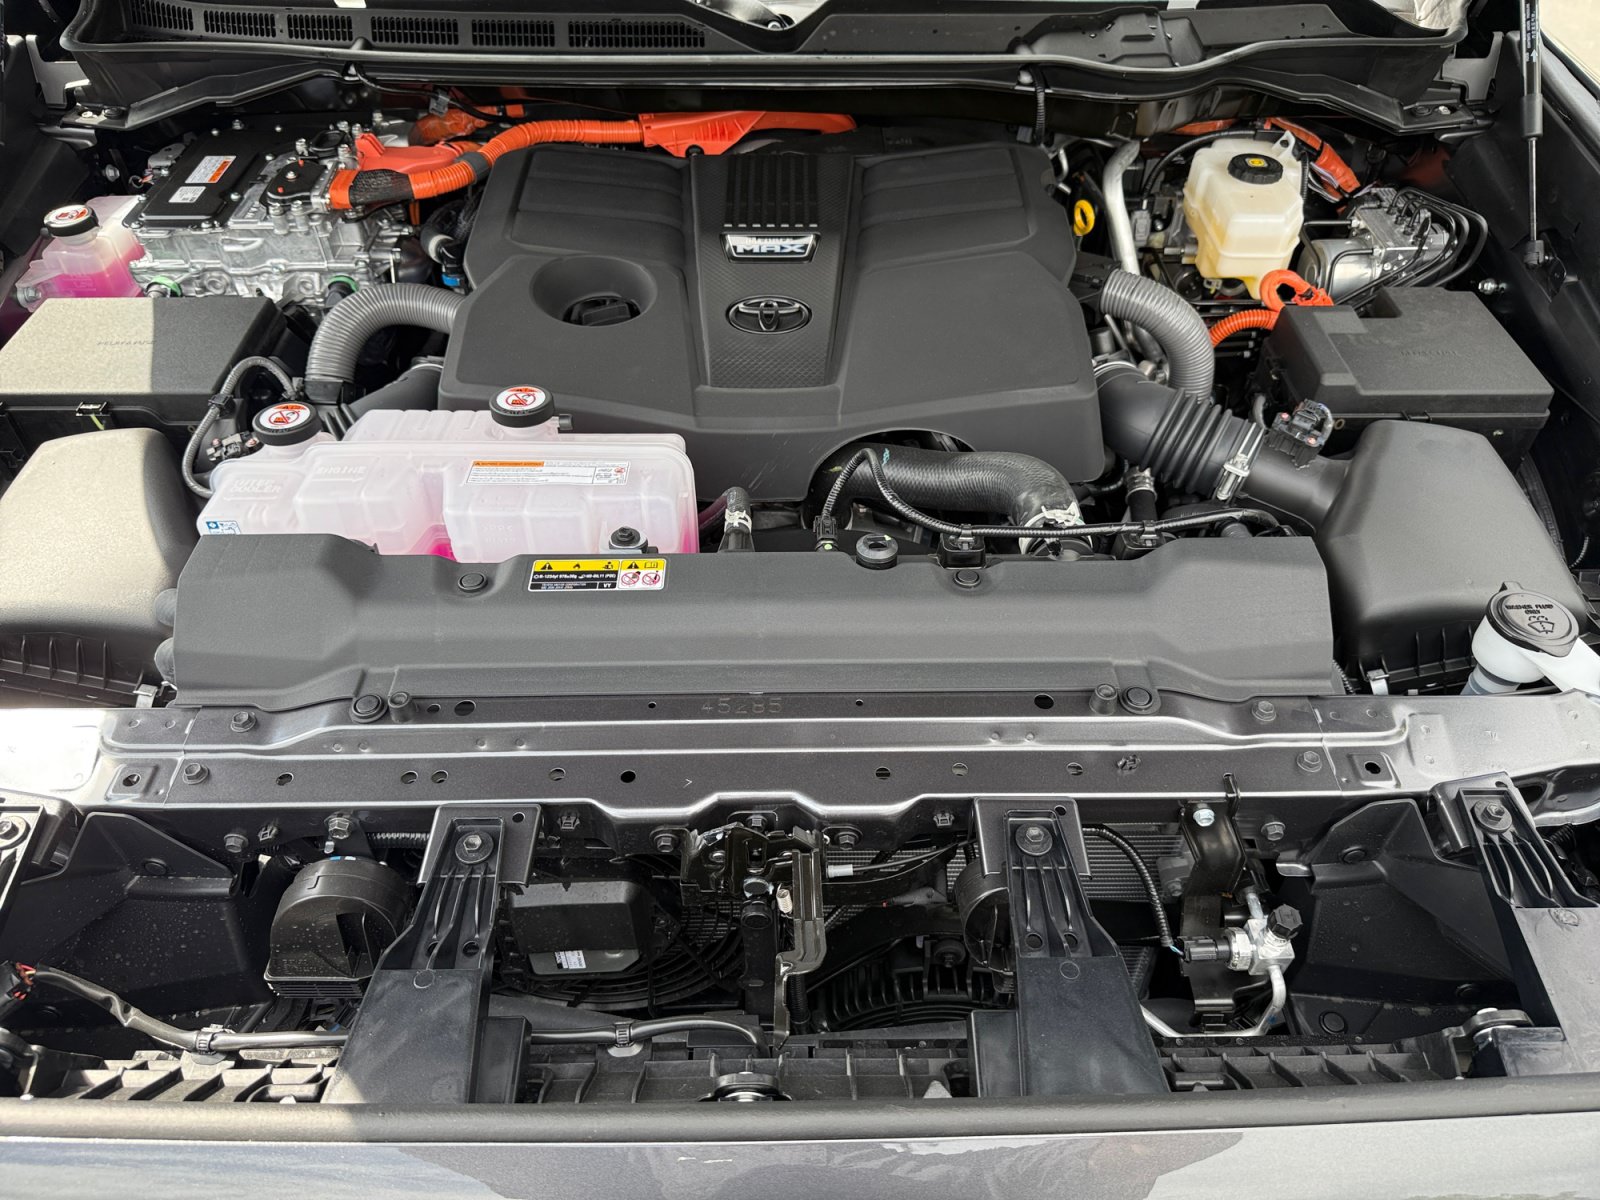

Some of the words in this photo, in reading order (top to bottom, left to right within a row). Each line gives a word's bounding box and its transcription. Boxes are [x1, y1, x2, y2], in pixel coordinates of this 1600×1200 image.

[736, 244, 806, 253] MAX
[316, 465, 368, 475] ENGINE
[701, 696, 783, 714] 45285
